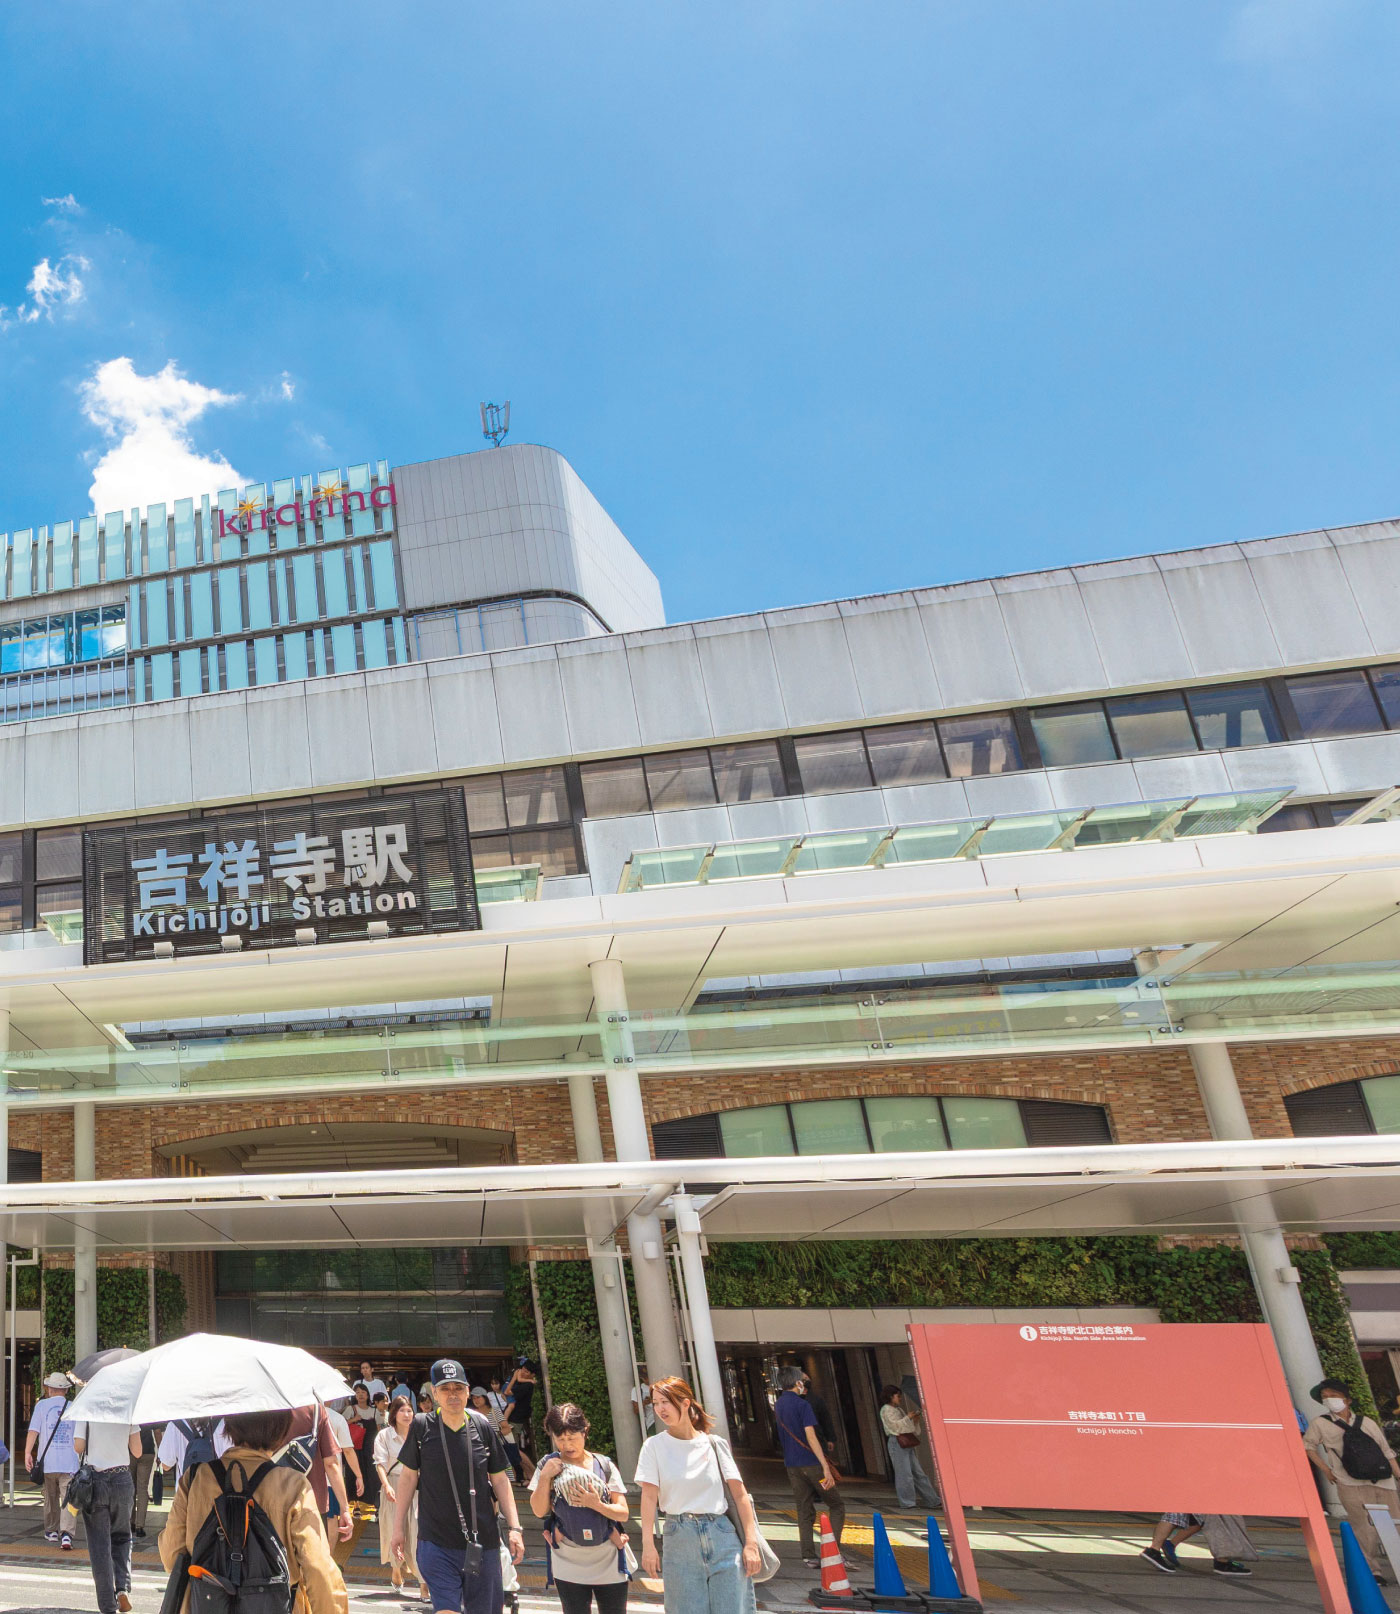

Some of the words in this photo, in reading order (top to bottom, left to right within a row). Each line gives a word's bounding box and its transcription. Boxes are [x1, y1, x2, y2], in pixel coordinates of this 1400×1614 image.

[218, 482, 397, 538] kirarina
[131, 824, 413, 910] 吉祥寺駅
[292, 889, 417, 921] Station
[1038, 1325, 1134, 1335] 吉祥寺駅北口総合案内
[1076, 1427, 1107, 1436] Kichijoji
[1108, 1427, 1137, 1435] Honcho
